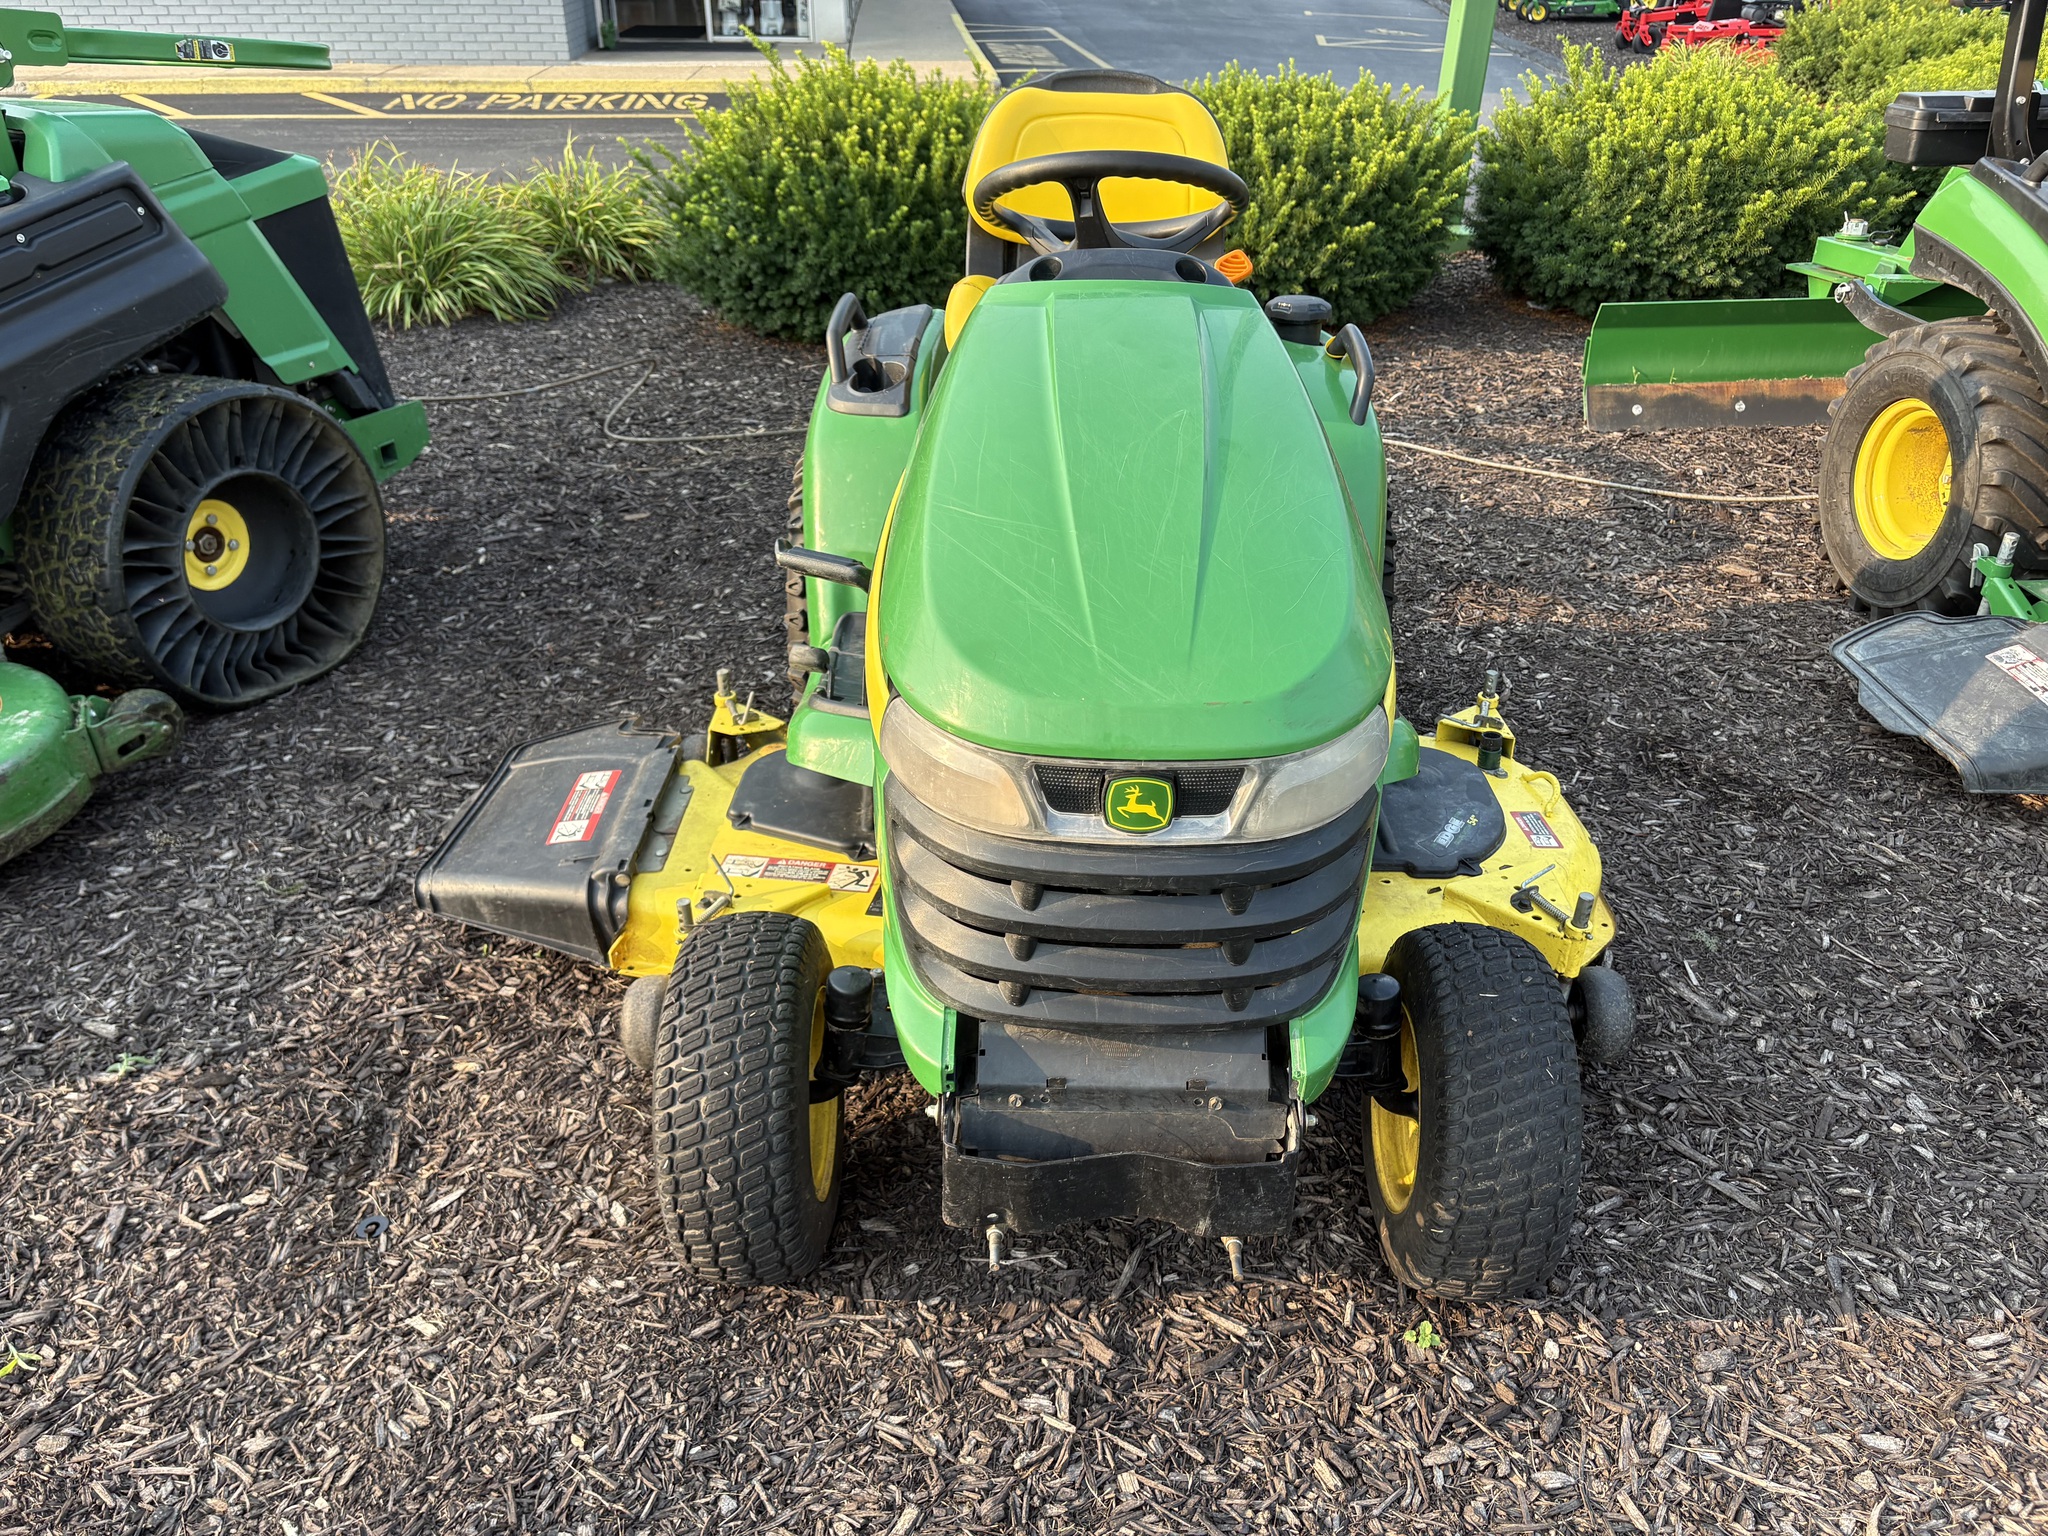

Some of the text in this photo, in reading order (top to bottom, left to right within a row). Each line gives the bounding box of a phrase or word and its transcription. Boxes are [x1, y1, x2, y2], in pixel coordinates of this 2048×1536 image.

[382, 93, 709, 110] NO PARKING
[1433, 816, 1466, 848] EDGE
[787, 859, 827, 867] DANGER
